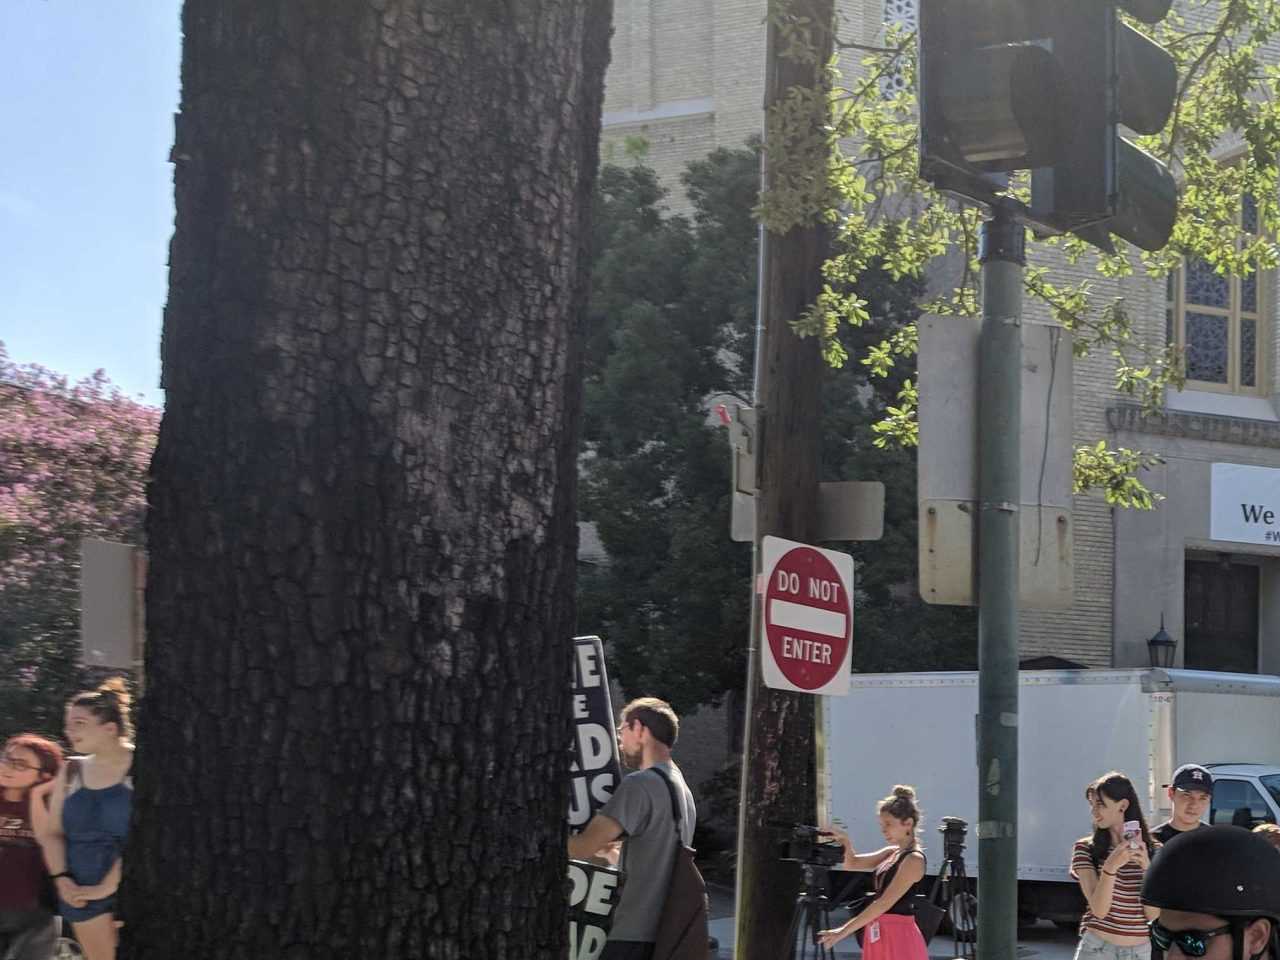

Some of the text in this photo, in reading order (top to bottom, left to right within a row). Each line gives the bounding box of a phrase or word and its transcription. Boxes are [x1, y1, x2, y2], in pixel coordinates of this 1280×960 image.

[1241, 503, 1275, 524] We
[777, 570, 841, 603] DO NOT
[782, 636, 832, 665] ENTER
